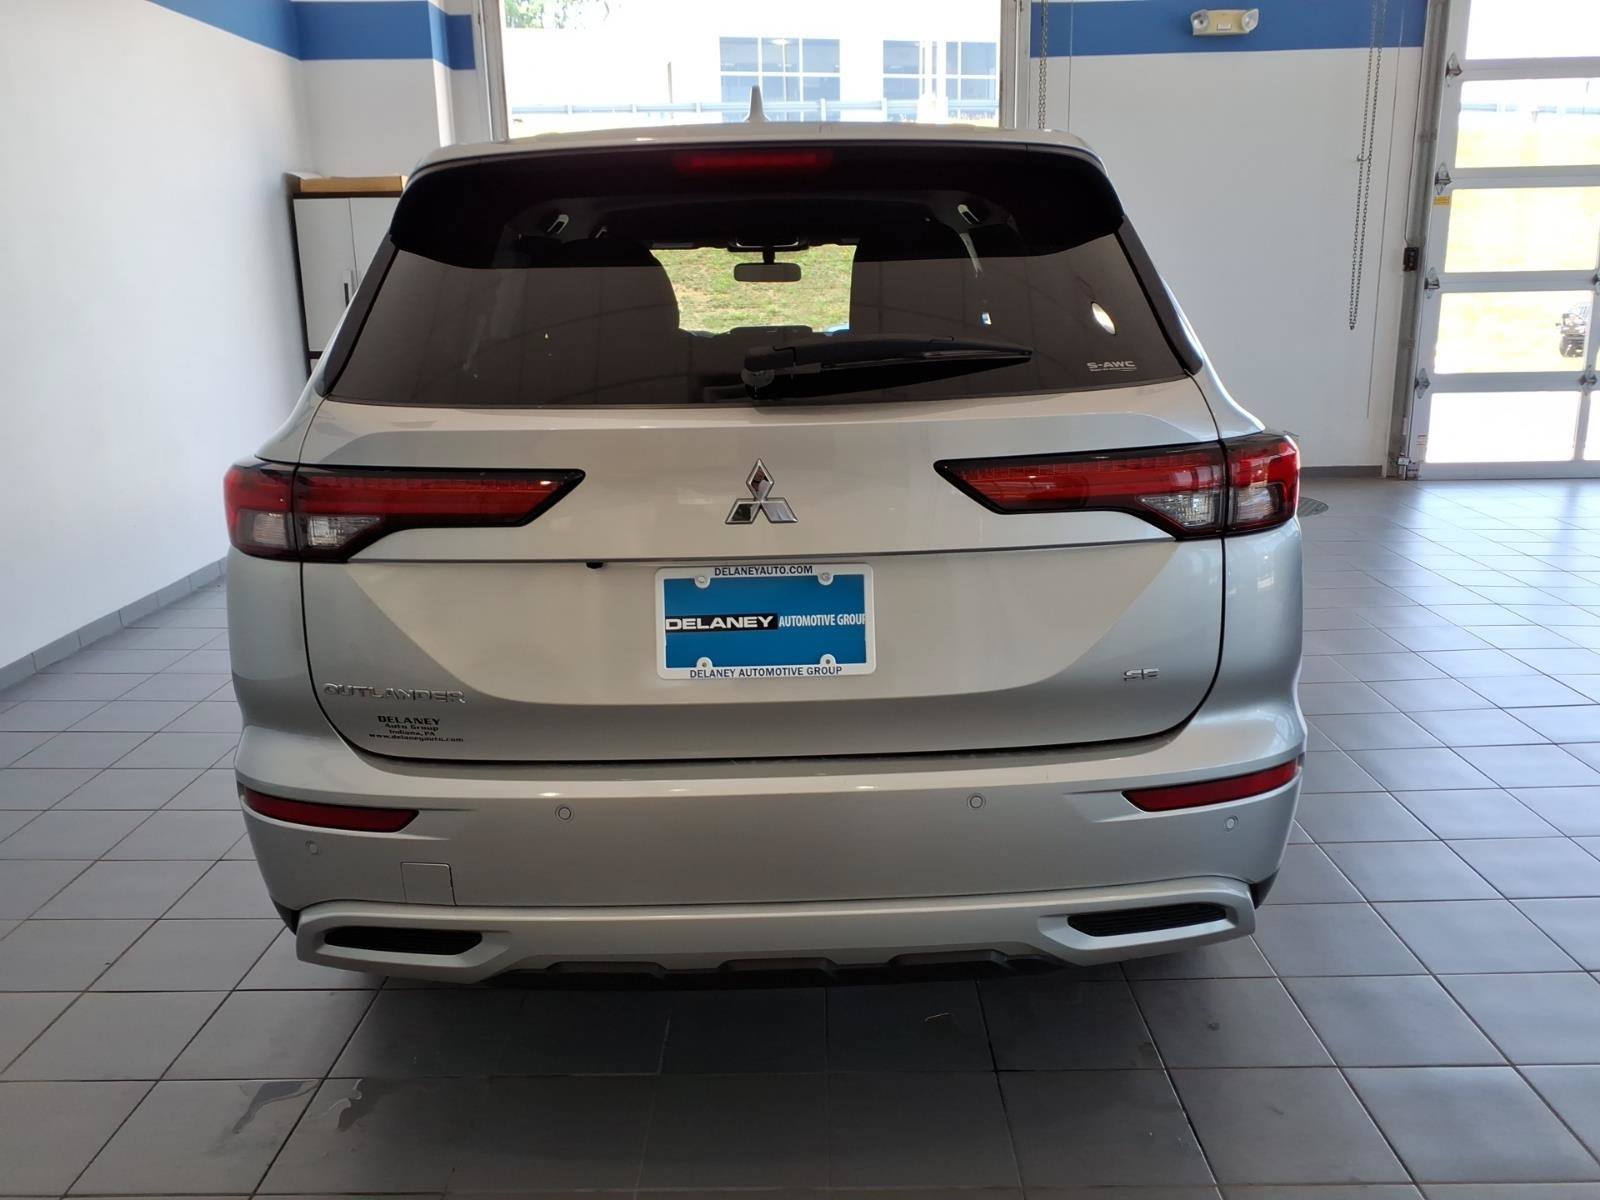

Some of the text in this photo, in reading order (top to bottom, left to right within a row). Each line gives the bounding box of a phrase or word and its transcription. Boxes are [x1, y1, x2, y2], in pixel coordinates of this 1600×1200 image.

[1087, 360, 1136, 368] S-AWC
[714, 565, 813, 576] DELANEYAUTO.COM
[665, 615, 774, 631] DELANEY
[778, 614, 836, 627] AUTOMOTIVE
[690, 666, 842, 678] DELANEY AUTOMOTIVE GROUP
[323, 683, 466, 703] OUTLANDER
[377, 715, 440, 725] DELANEY
[410, 724, 439, 732] Group
[368, 733, 464, 742] www.delaneyauto.com
